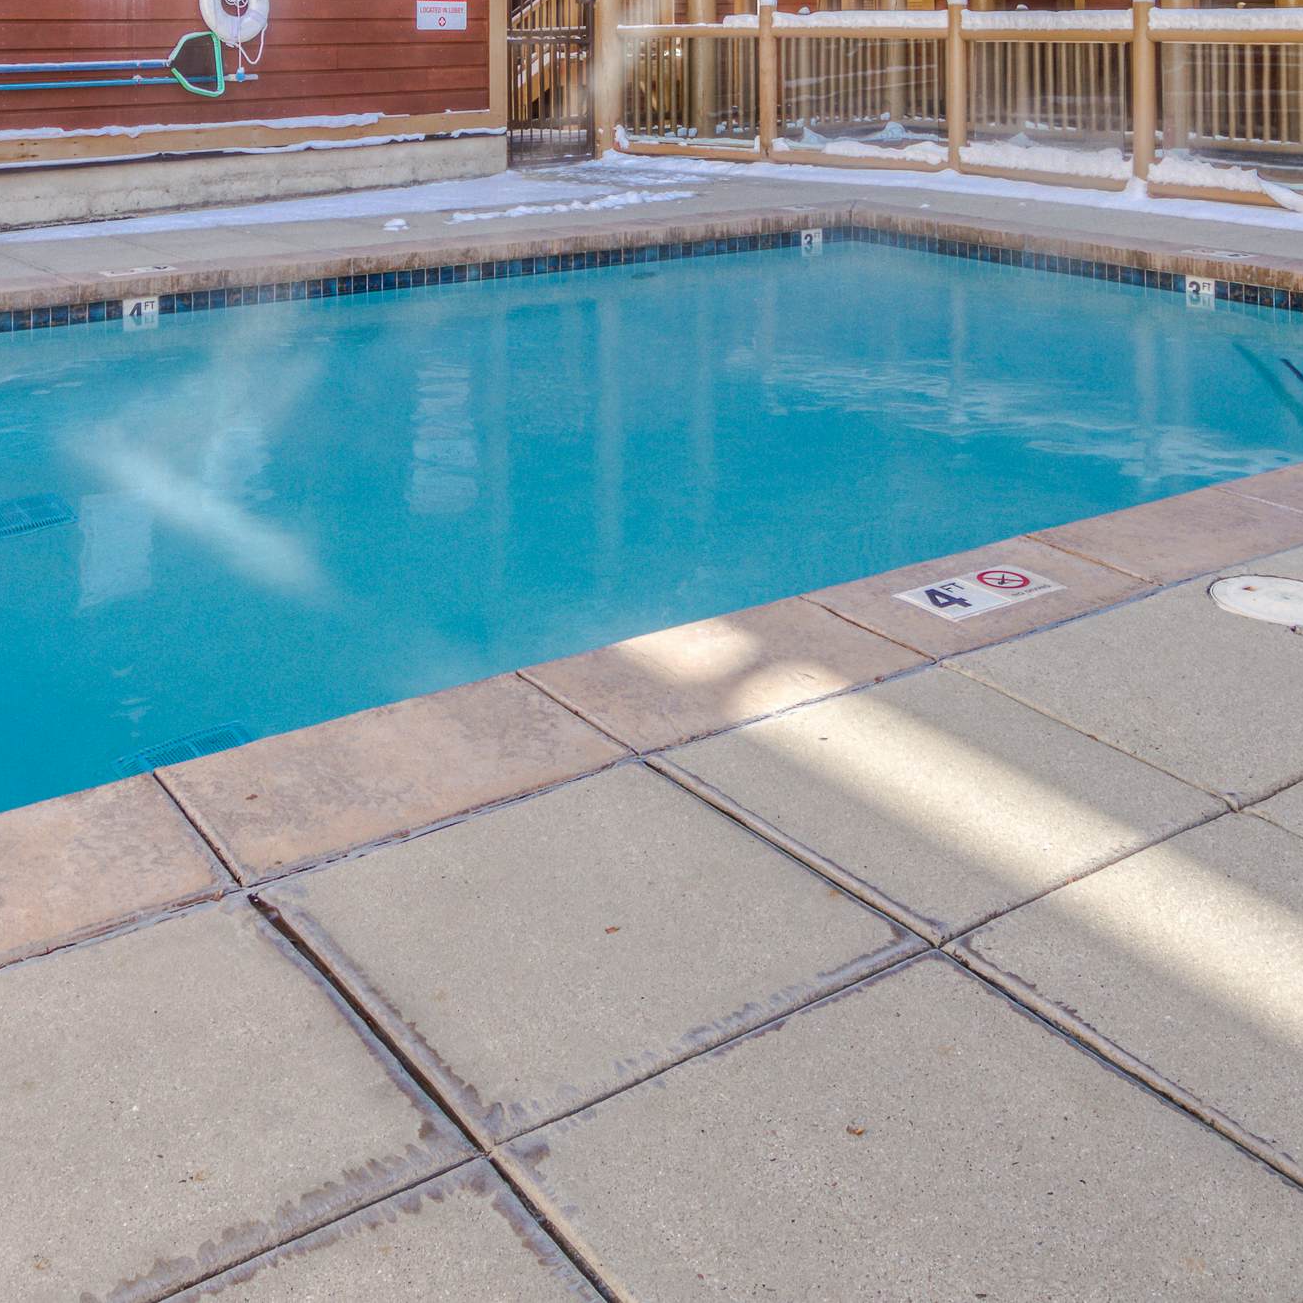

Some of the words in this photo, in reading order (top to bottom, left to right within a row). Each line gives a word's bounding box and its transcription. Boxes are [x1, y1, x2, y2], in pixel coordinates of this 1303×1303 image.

[1202, 281, 1211, 292] FT
[144, 300, 155, 310] FT
[924, 588, 973, 608] 4
